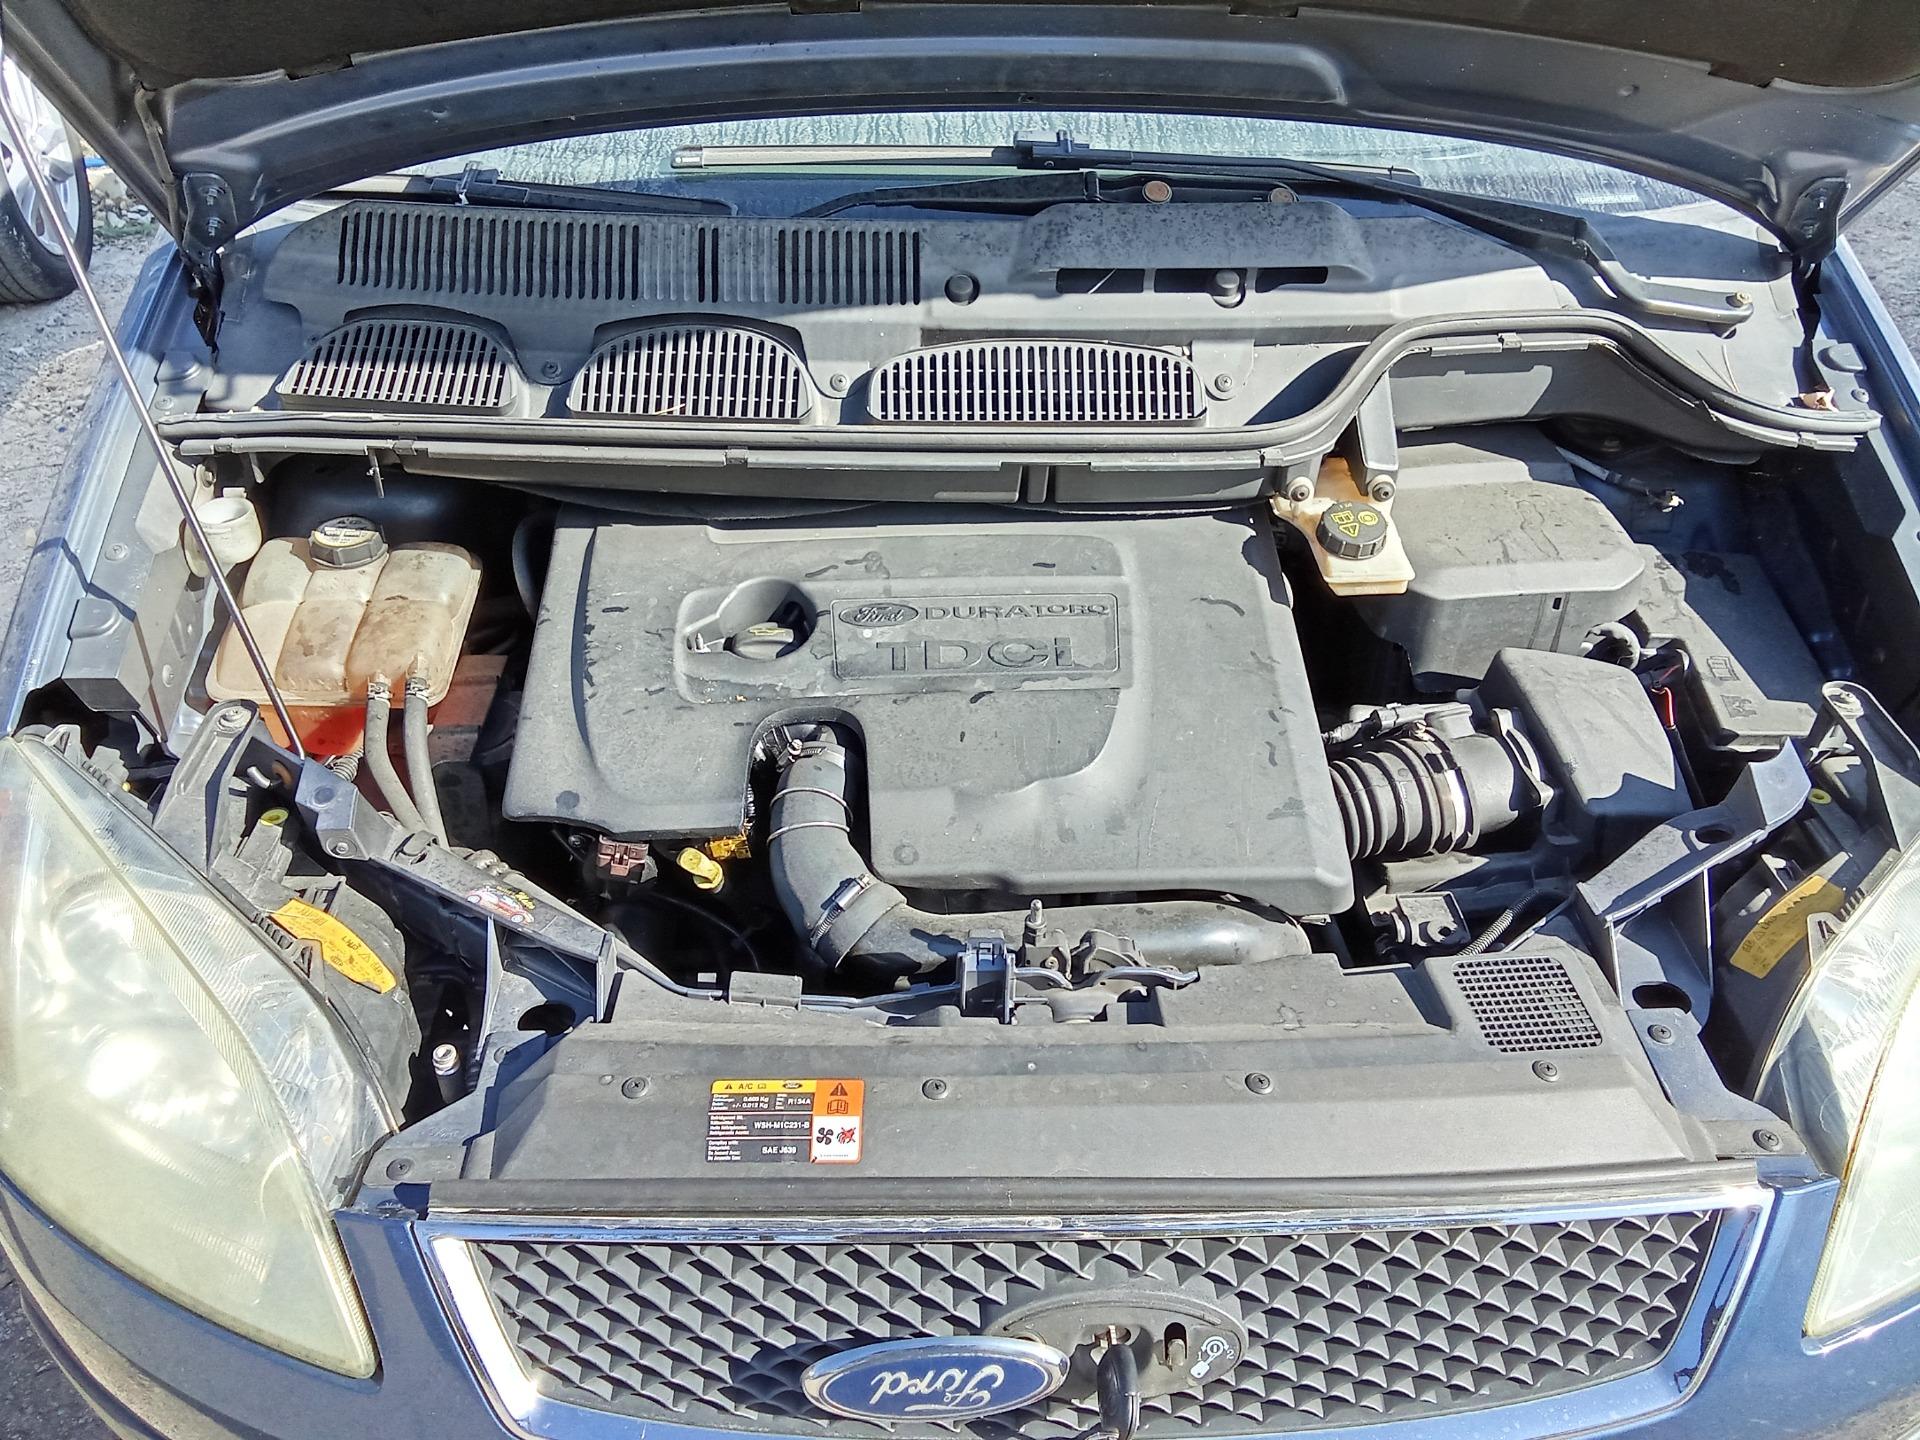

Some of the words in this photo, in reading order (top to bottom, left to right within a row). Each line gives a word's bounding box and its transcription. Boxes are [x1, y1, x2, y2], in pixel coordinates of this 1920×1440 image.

[853, 606, 903, 623] Ford
[925, 604, 1110, 620] DURATORQ
[1226, 1349, 1235, 1360] 2
[870, 1364, 1005, 1412] Ford
